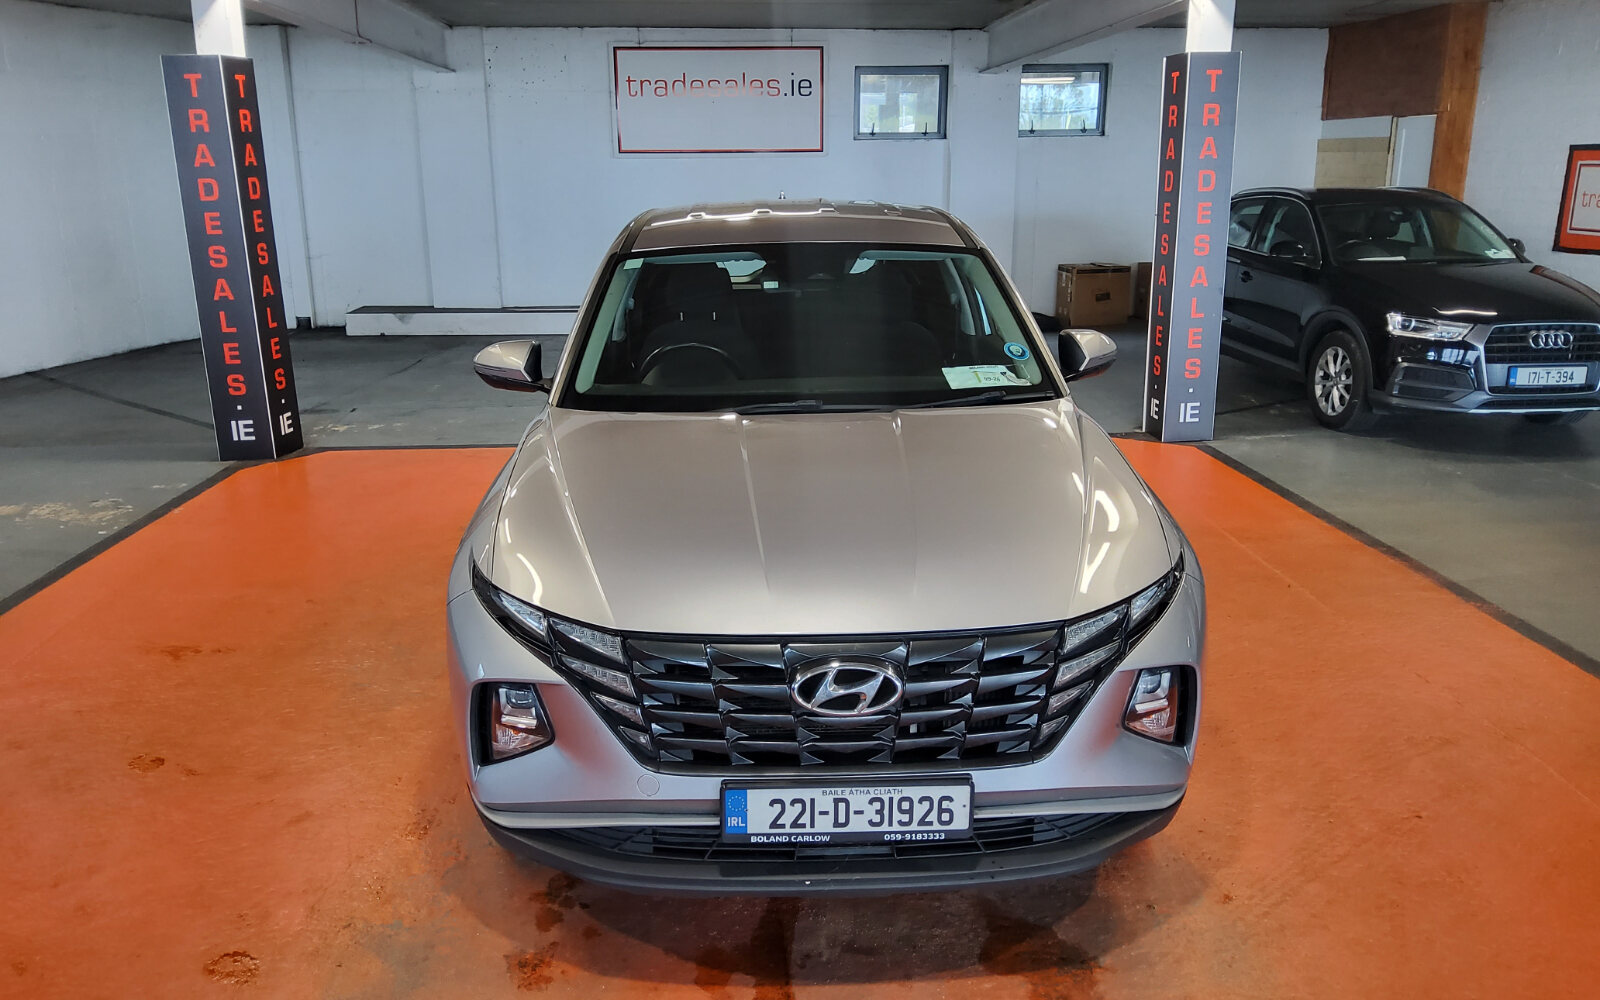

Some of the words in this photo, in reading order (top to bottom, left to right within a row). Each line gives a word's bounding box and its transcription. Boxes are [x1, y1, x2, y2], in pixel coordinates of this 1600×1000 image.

[625, 72, 813, 98] tradesales.ie
[1527, 370, 1575, 384] 171-T-394
[873, 788, 903, 796] CLIATH
[768, 795, 955, 830] 221-D-31926
[727, 816, 746, 828] IRL
[750, 835, 789, 843] BOLAND
[791, 834, 831, 843] CARLOW
[883, 832, 945, 841] 059-9183333
